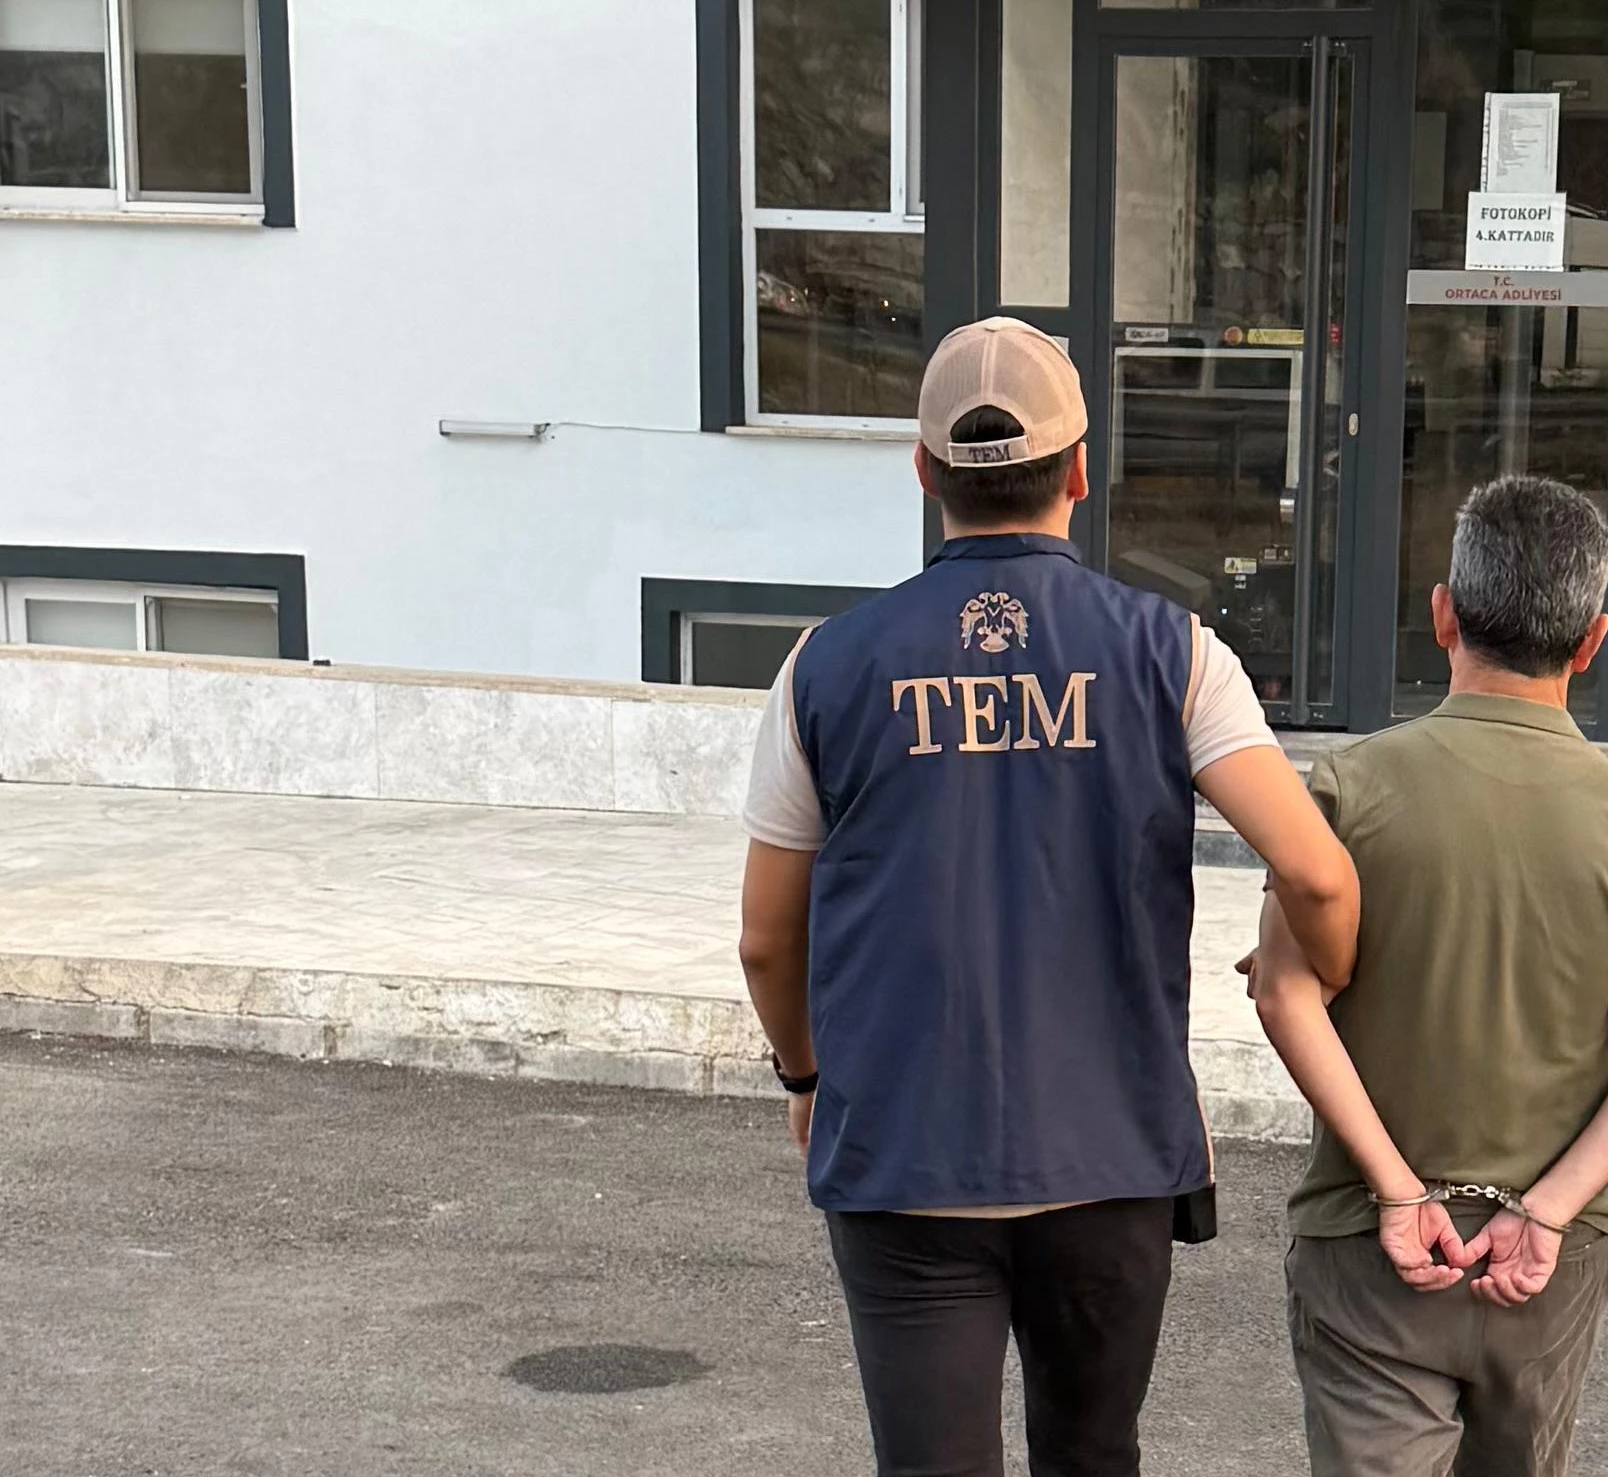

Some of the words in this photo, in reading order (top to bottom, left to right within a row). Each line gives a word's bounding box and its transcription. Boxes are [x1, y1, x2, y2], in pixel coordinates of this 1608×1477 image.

[1480, 205, 1552, 221] FOTOKOPİ
[1445, 288, 1498, 300] ORTACA
[1502, 287, 1562, 301] ADLİYESİ
[892, 672, 1098, 755] TEM
